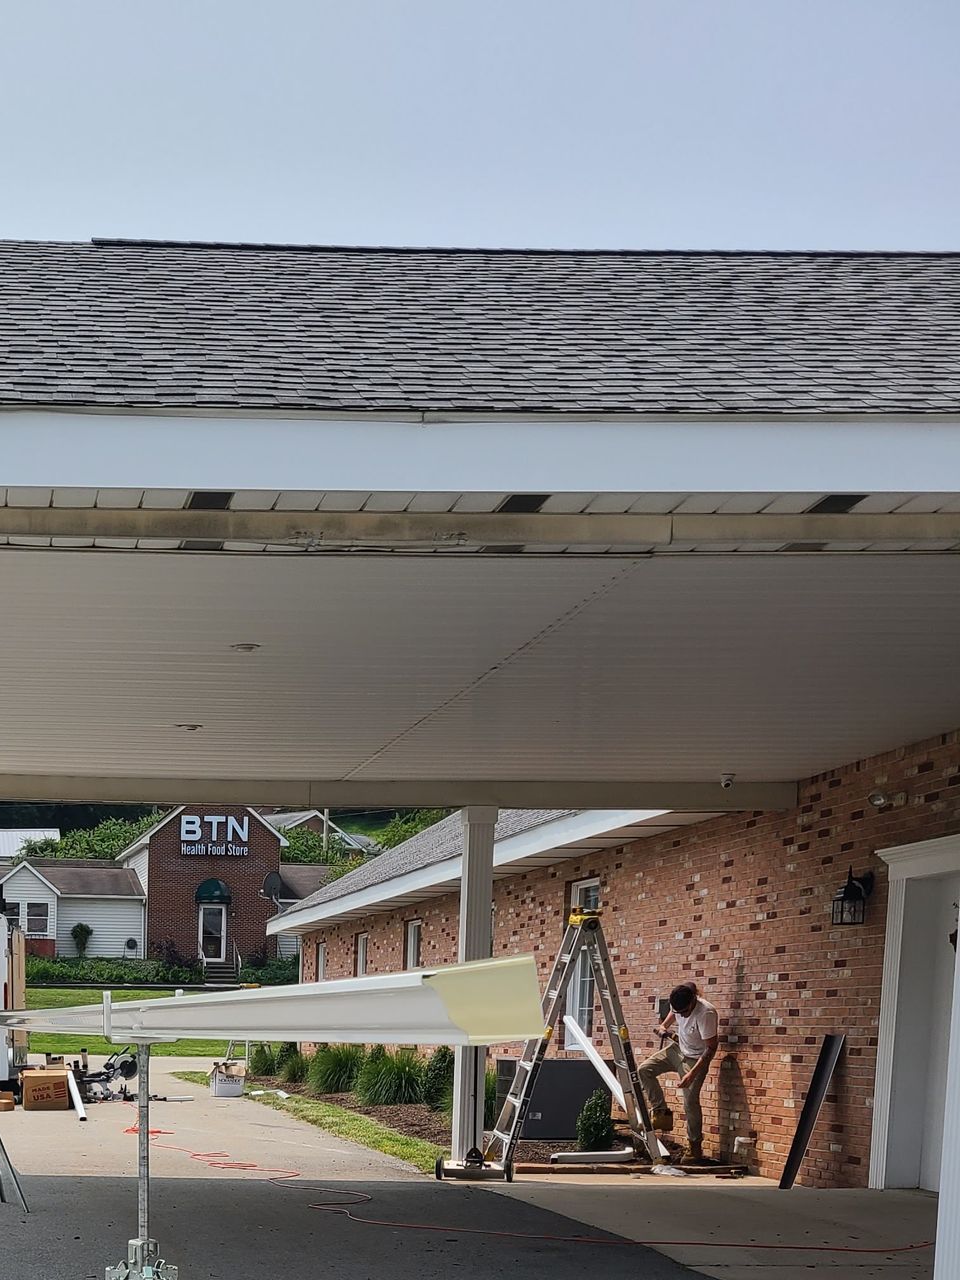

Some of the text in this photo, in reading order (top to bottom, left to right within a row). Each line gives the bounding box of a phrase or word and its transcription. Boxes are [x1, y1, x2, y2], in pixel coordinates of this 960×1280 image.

[181, 815, 249, 841] BTN
[181, 843, 249, 856] Health Food Store
[33, 1093, 52, 1101] USA
